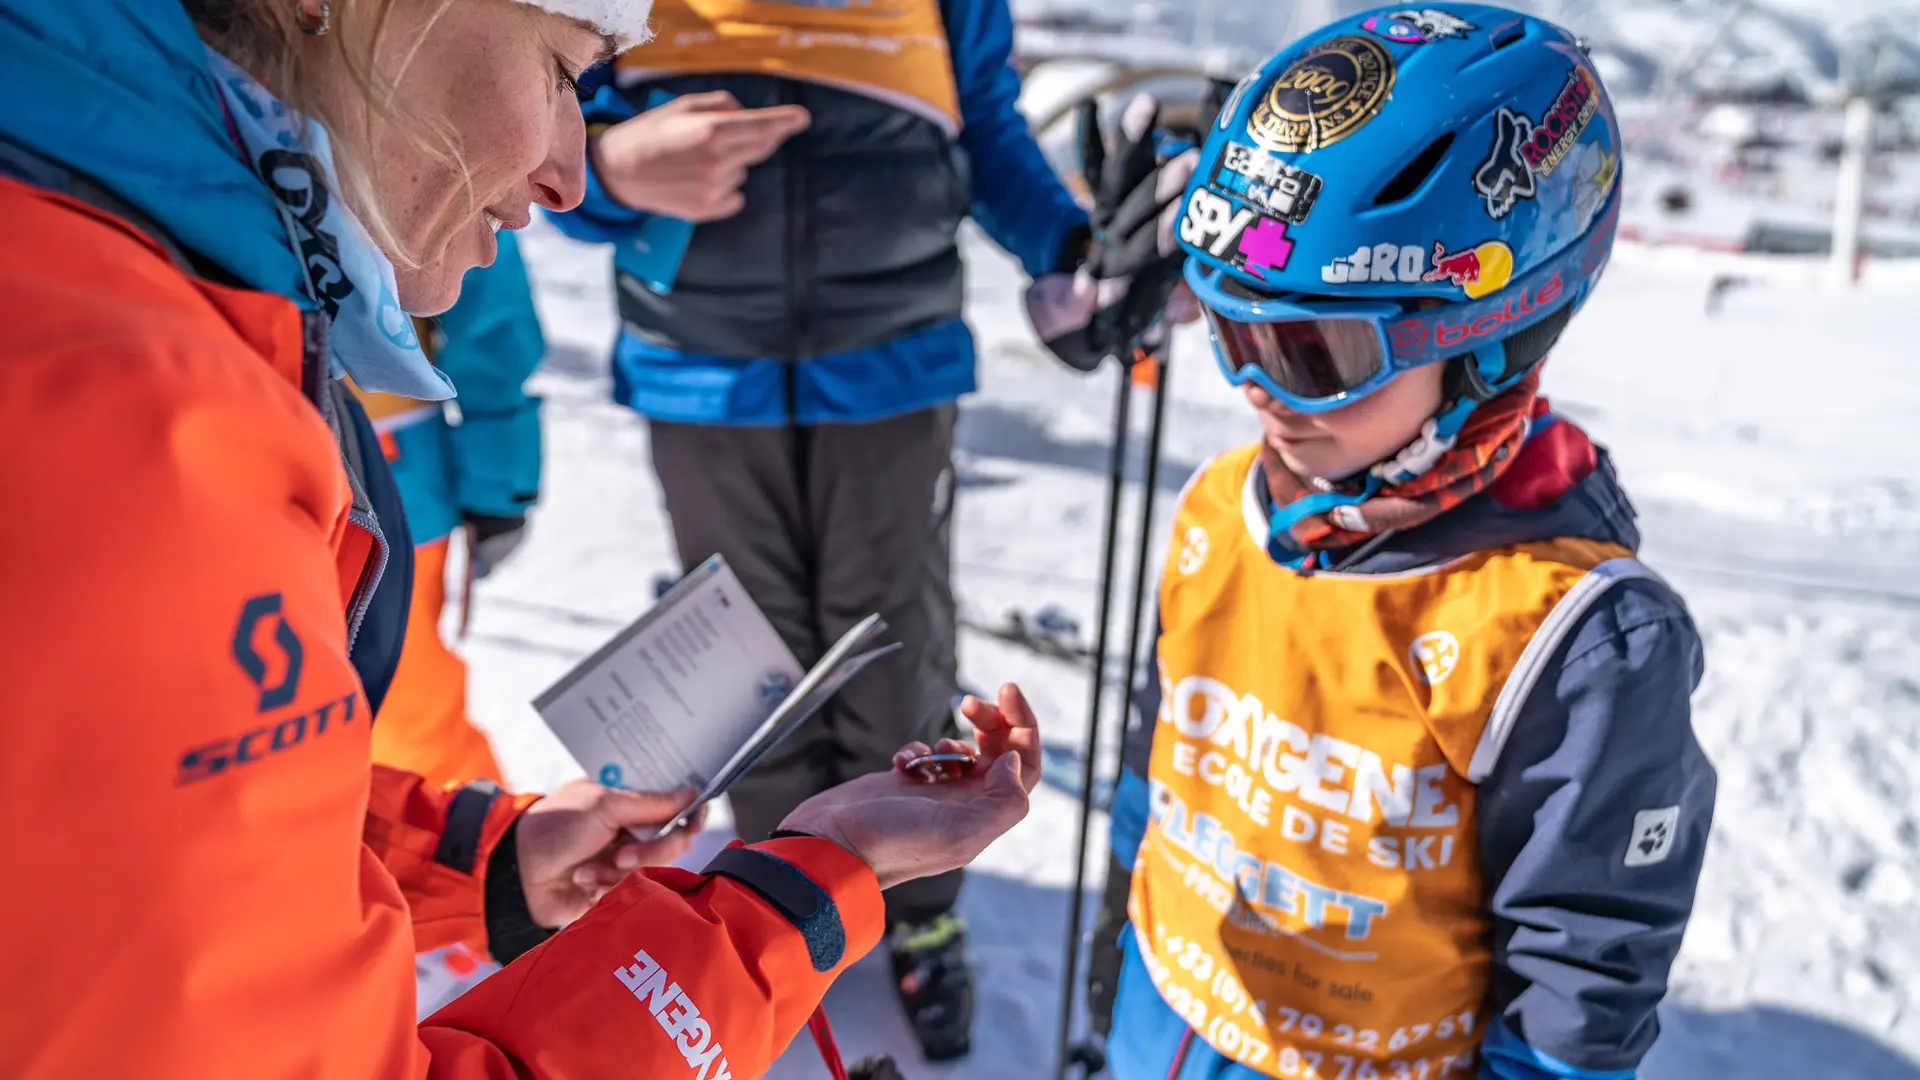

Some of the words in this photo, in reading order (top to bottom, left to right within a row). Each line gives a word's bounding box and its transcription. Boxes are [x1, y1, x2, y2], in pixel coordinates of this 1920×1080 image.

[1541, 121, 1580, 174] ENERGY
[1180, 187, 1254, 257] SPY
[1322, 243, 1424, 283] GIRO
[1435, 269, 1563, 347] bollé
[173, 692, 358, 788] SCOTT
[1172, 675, 1458, 827] OXYGENE
[1172, 741, 1273, 827] ECOLE
[1281, 804, 1350, 855] DE
[1367, 834, 1455, 870] SKI
[1278, 1047, 1323, 1079] 87
[1388, 1023, 1431, 1051] 67
